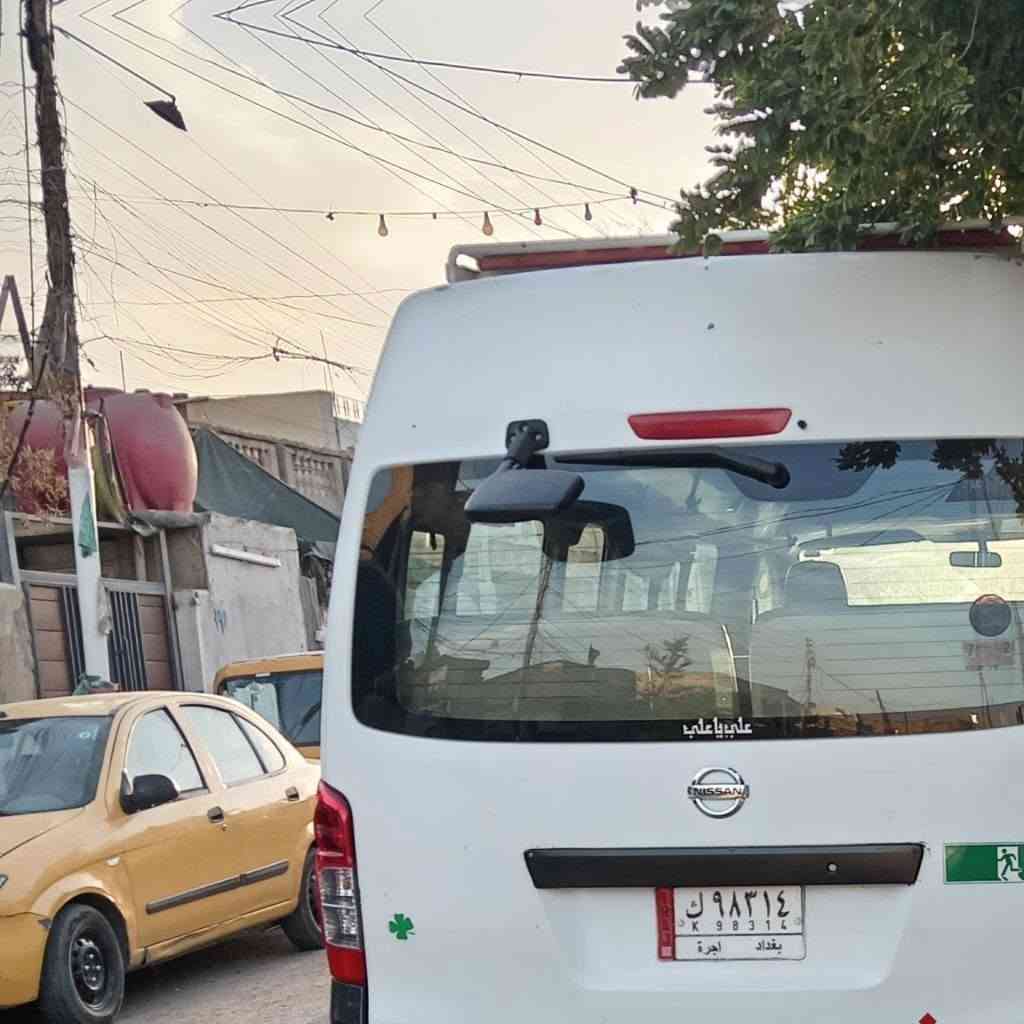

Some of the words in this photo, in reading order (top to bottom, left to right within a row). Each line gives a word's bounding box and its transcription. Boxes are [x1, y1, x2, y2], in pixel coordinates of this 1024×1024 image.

[694, 787, 741, 797] NISSAN
[712, 890, 790, 918] ٩٨٣١٤
[716, 920, 787, 931] 98314
[755, 939, 782, 954] بغداد
